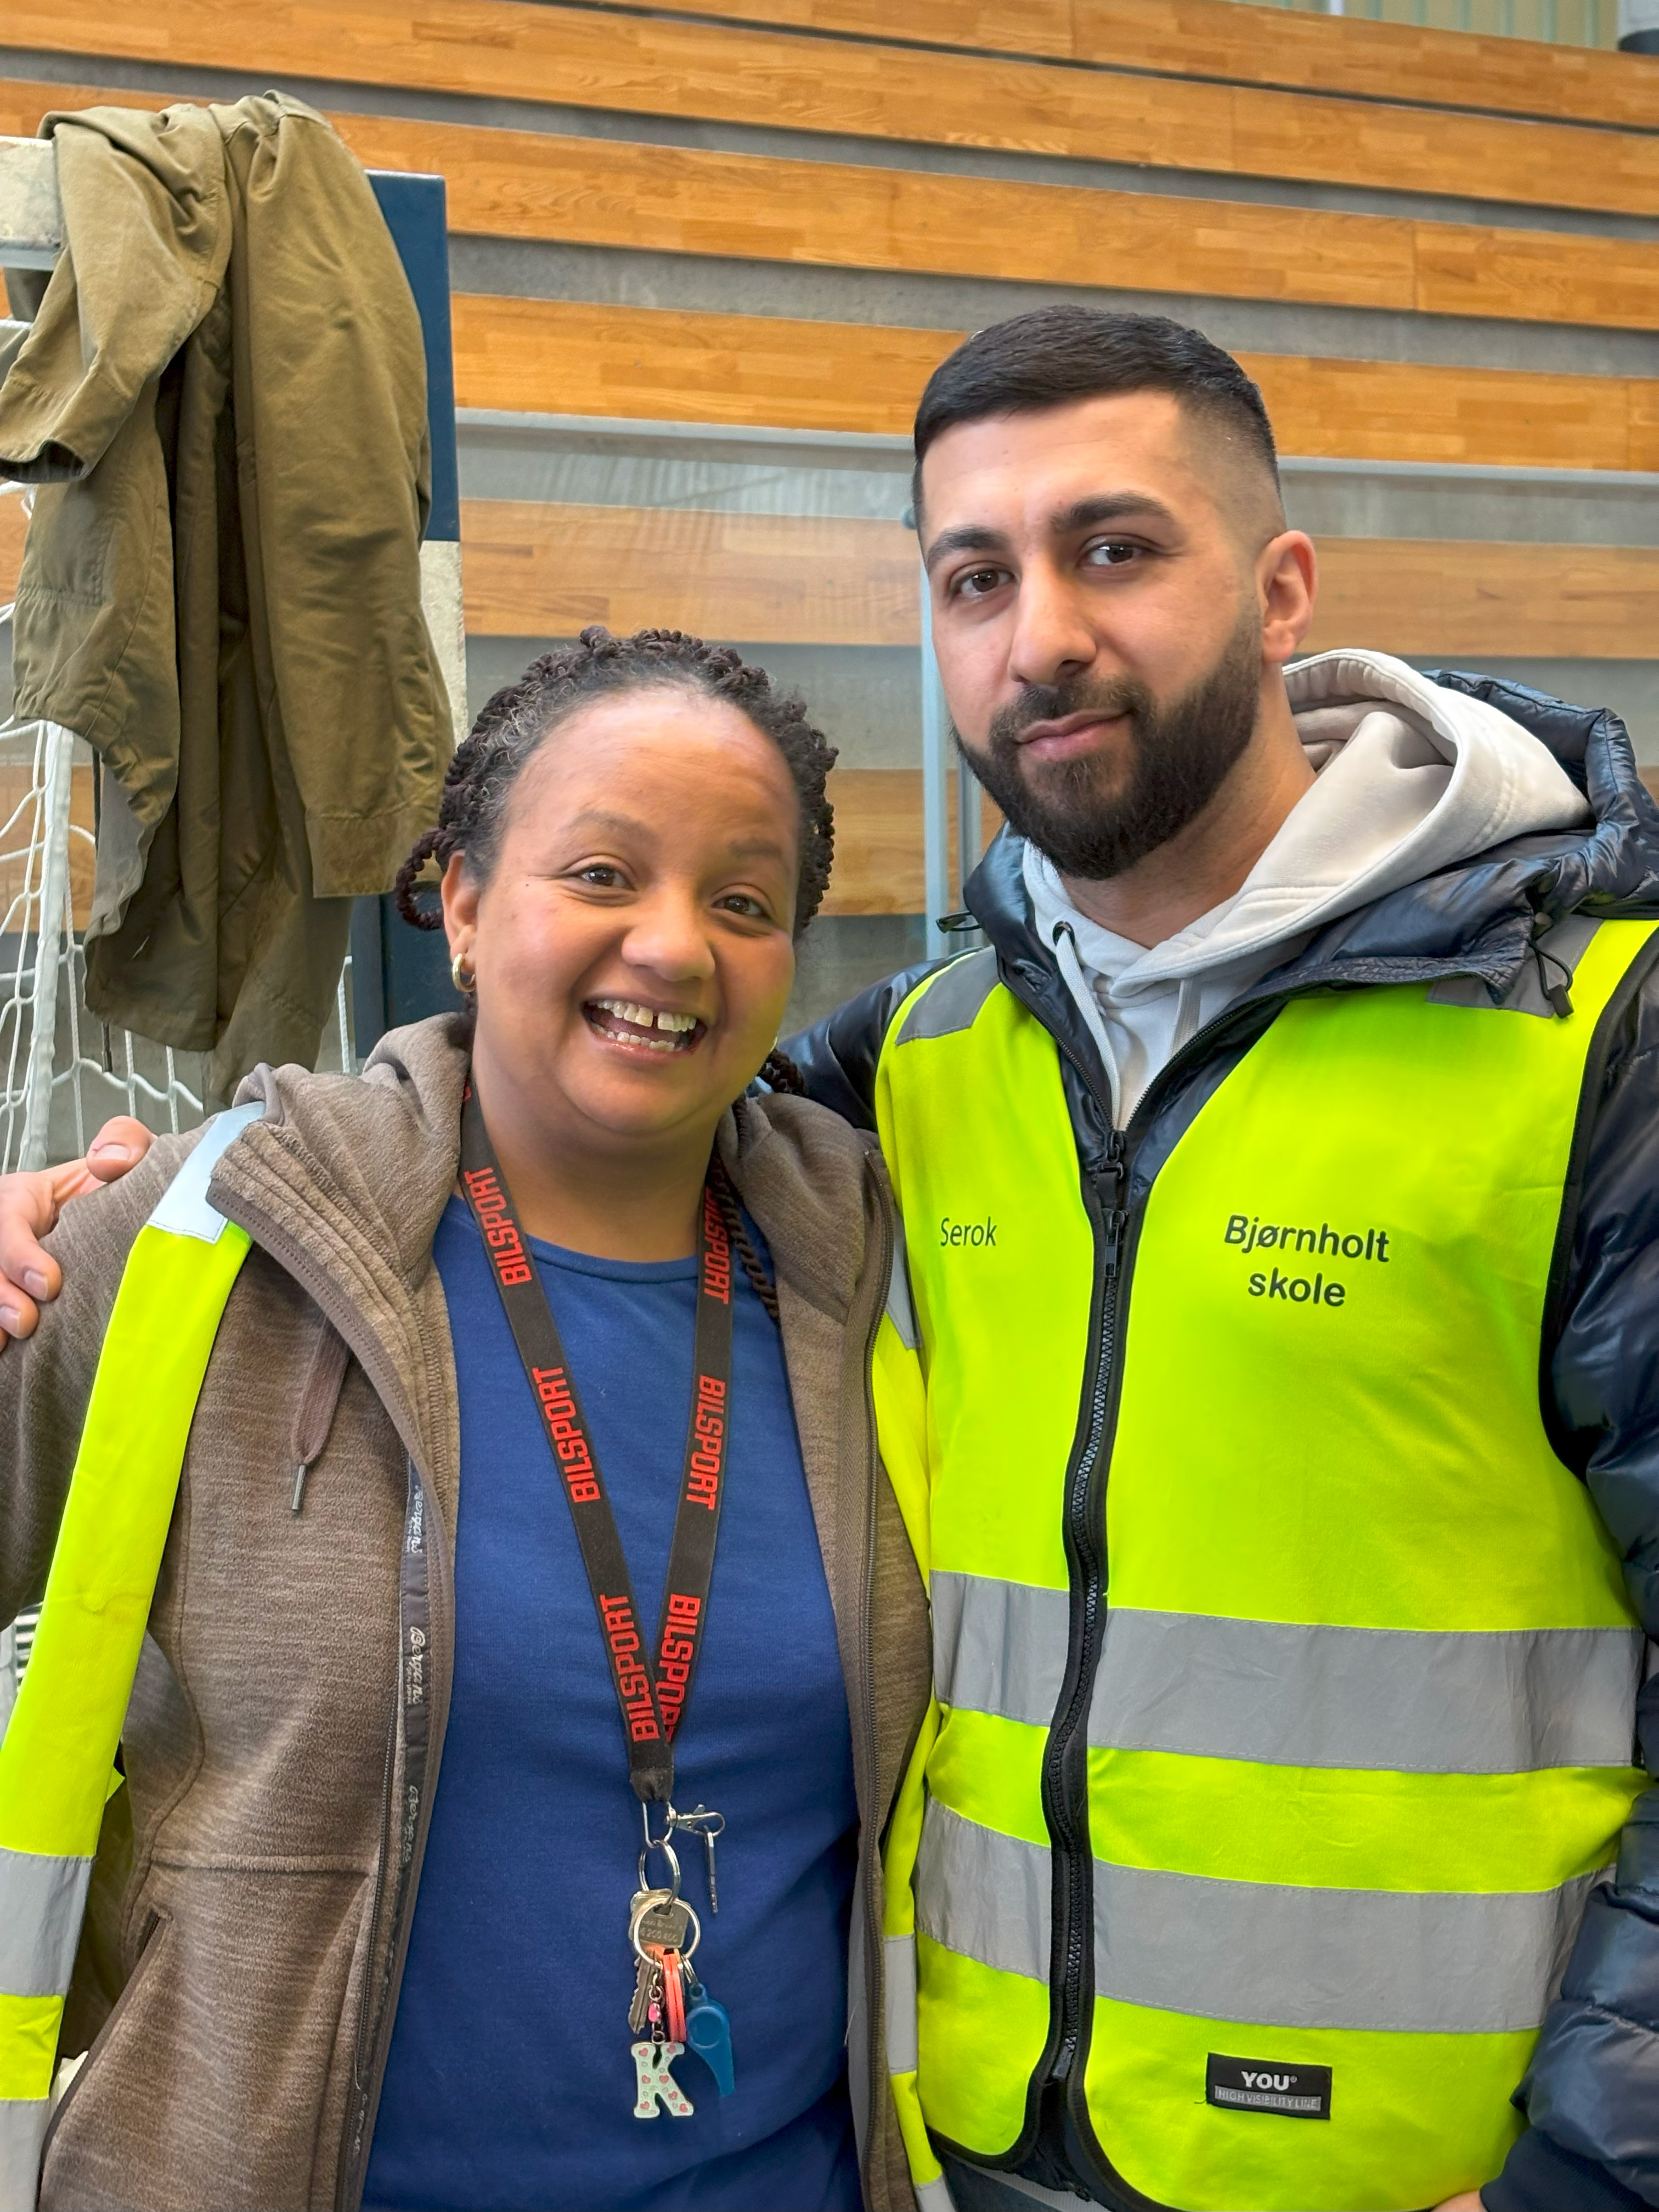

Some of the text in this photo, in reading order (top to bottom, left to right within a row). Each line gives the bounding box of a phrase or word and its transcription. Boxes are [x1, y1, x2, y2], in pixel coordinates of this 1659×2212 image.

[464, 1166, 533, 1286] BILSPORT
[940, 1217, 996, 1246] Serok
[1225, 1216, 1390, 1263] Bjørnholt
[1248, 1268, 1346, 1307] skole
[531, 1366, 601, 1503] BILSPORT
[685, 1374, 726, 1511] BILSPORT
[409, 1626, 426, 1704] Bergans
[600, 1593, 660, 1742] BILSPORT
[631, 2042, 694, 2118] K
[1218, 2089, 1245, 2103] HIGH
